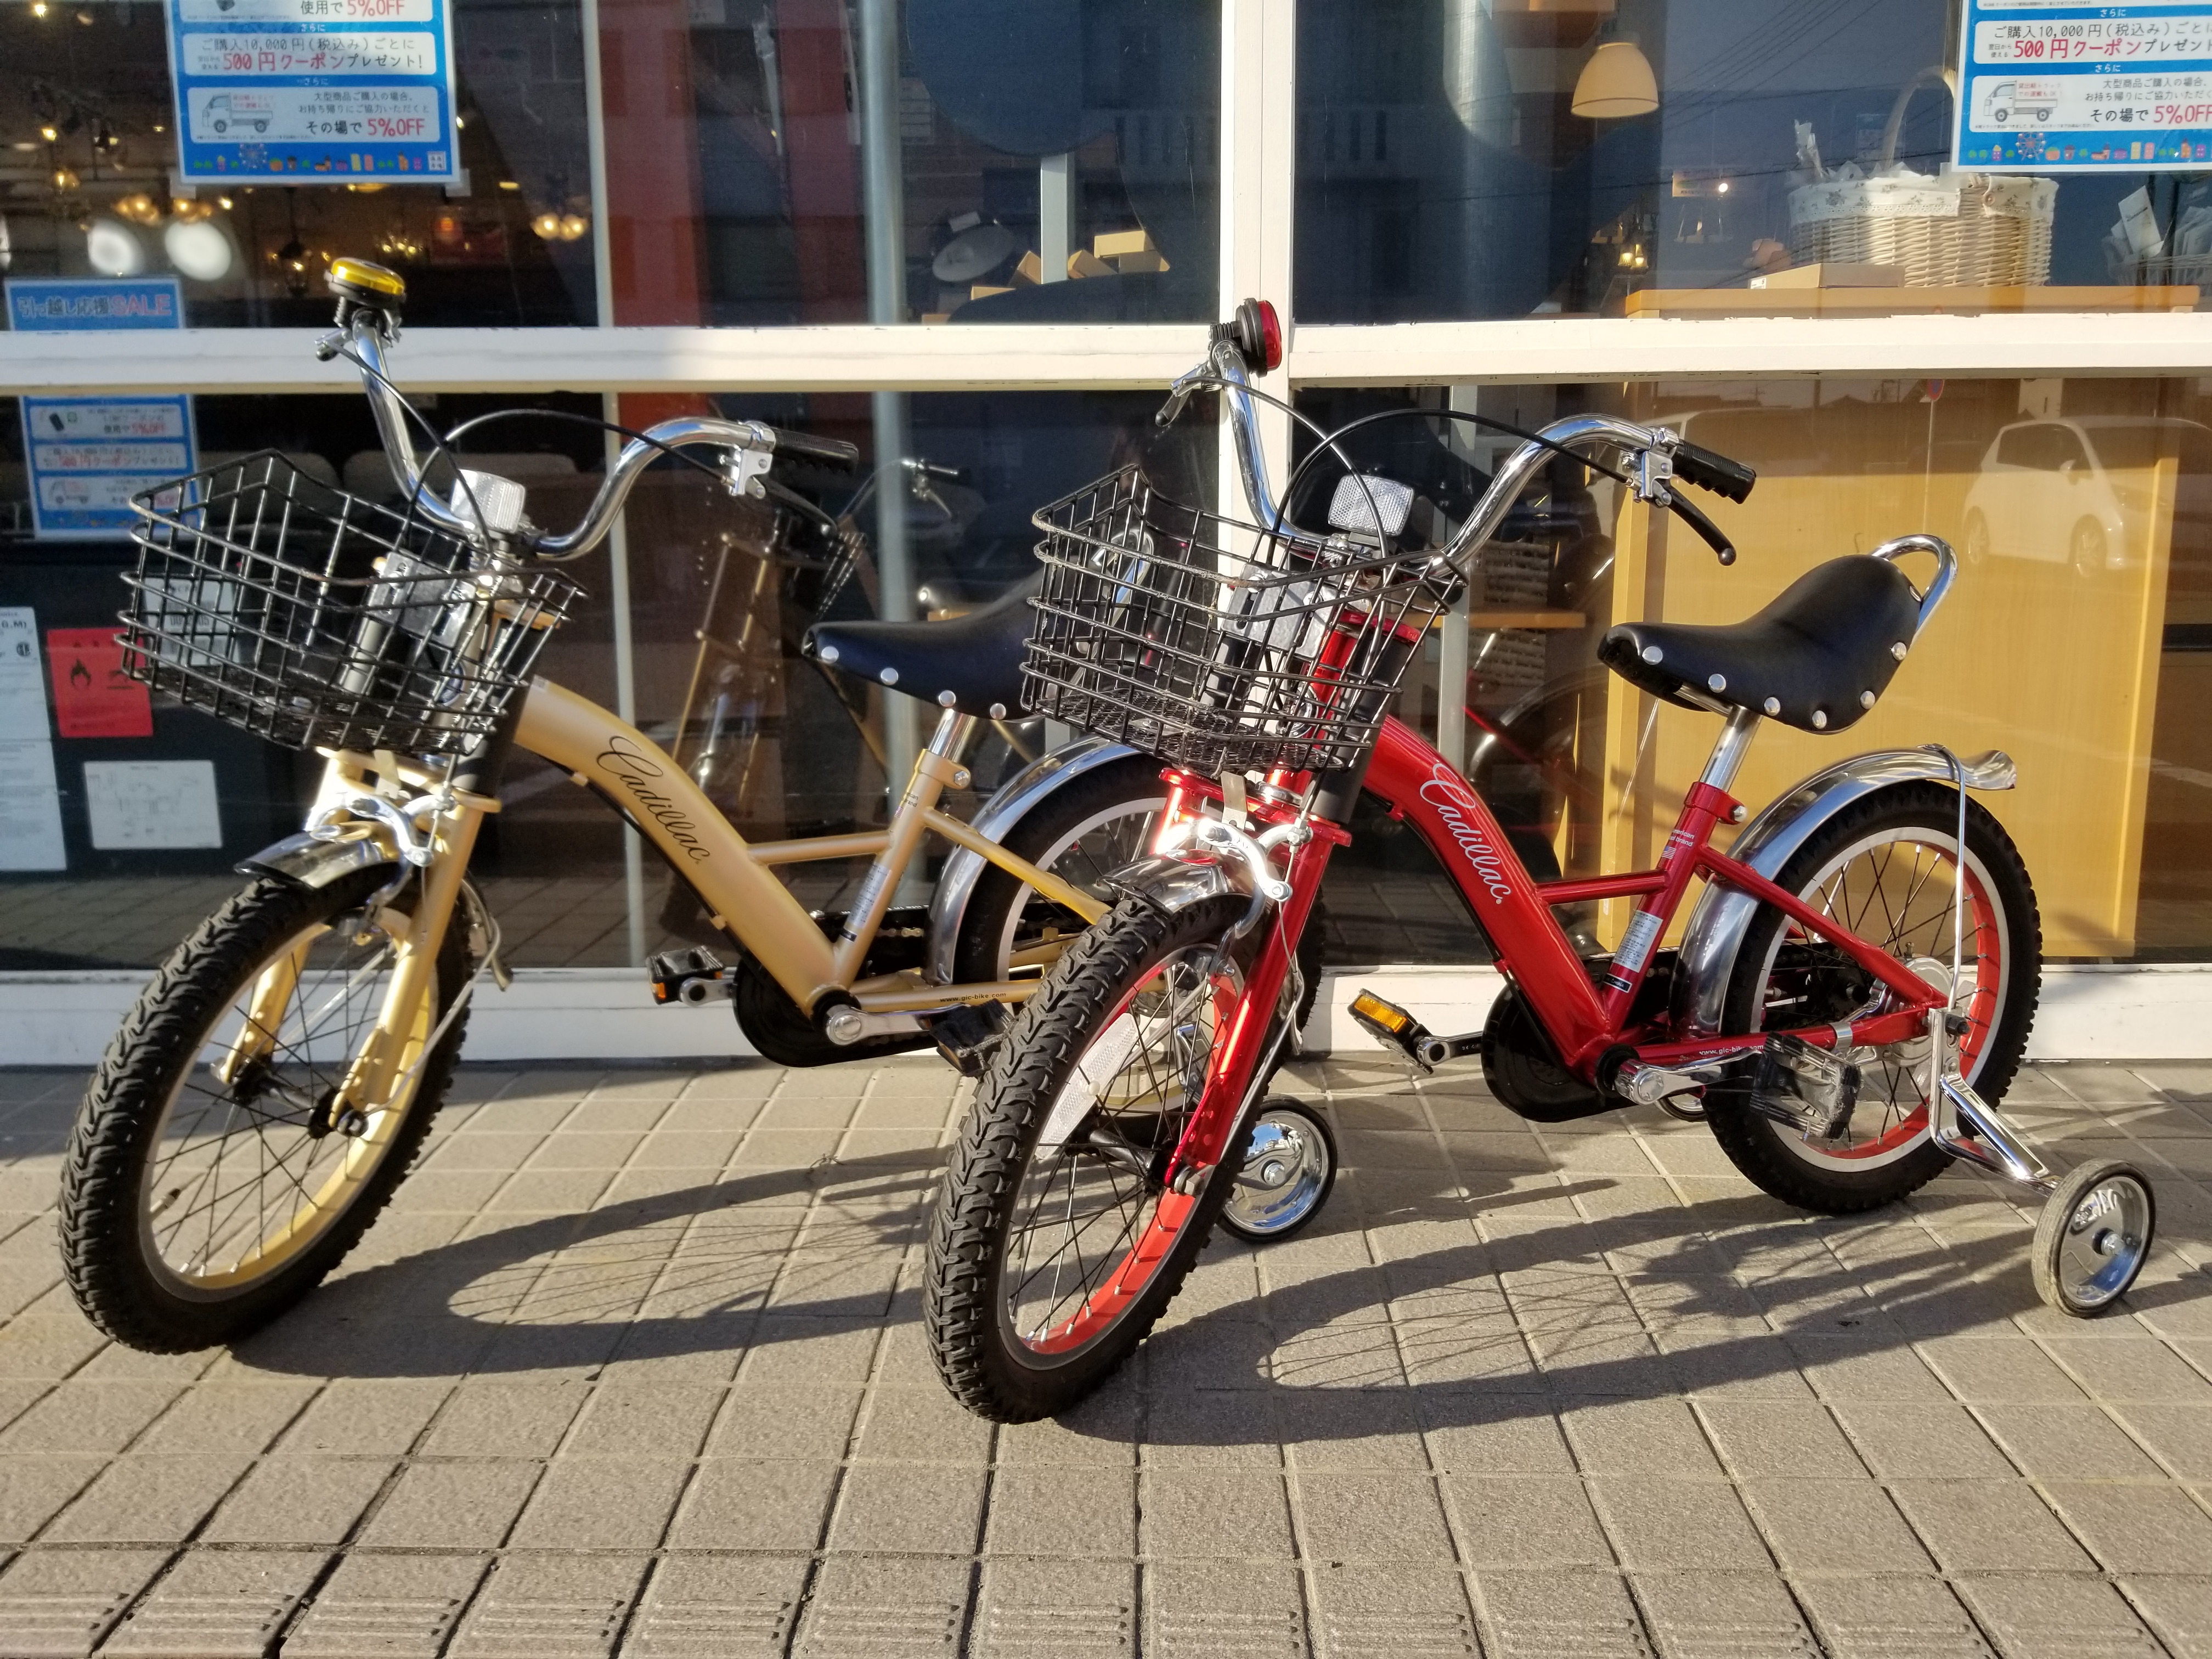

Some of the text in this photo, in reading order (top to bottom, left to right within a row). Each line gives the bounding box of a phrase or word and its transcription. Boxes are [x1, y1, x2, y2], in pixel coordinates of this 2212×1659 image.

[2100, 8, 2126, 18] さらに
[2095, 64, 2121, 72] さらに
[2090, 108, 2149, 123] その場で
[306, 117, 426, 137] その場で 5%OFF
[596, 736, 710, 862] Cadillac
[1419, 763, 1511, 901] Cadillac
[1672, 829, 1695, 839] merican
[1675, 836, 1694, 847] brand
[940, 992, 1007, 1002] www.gic-bike.com
